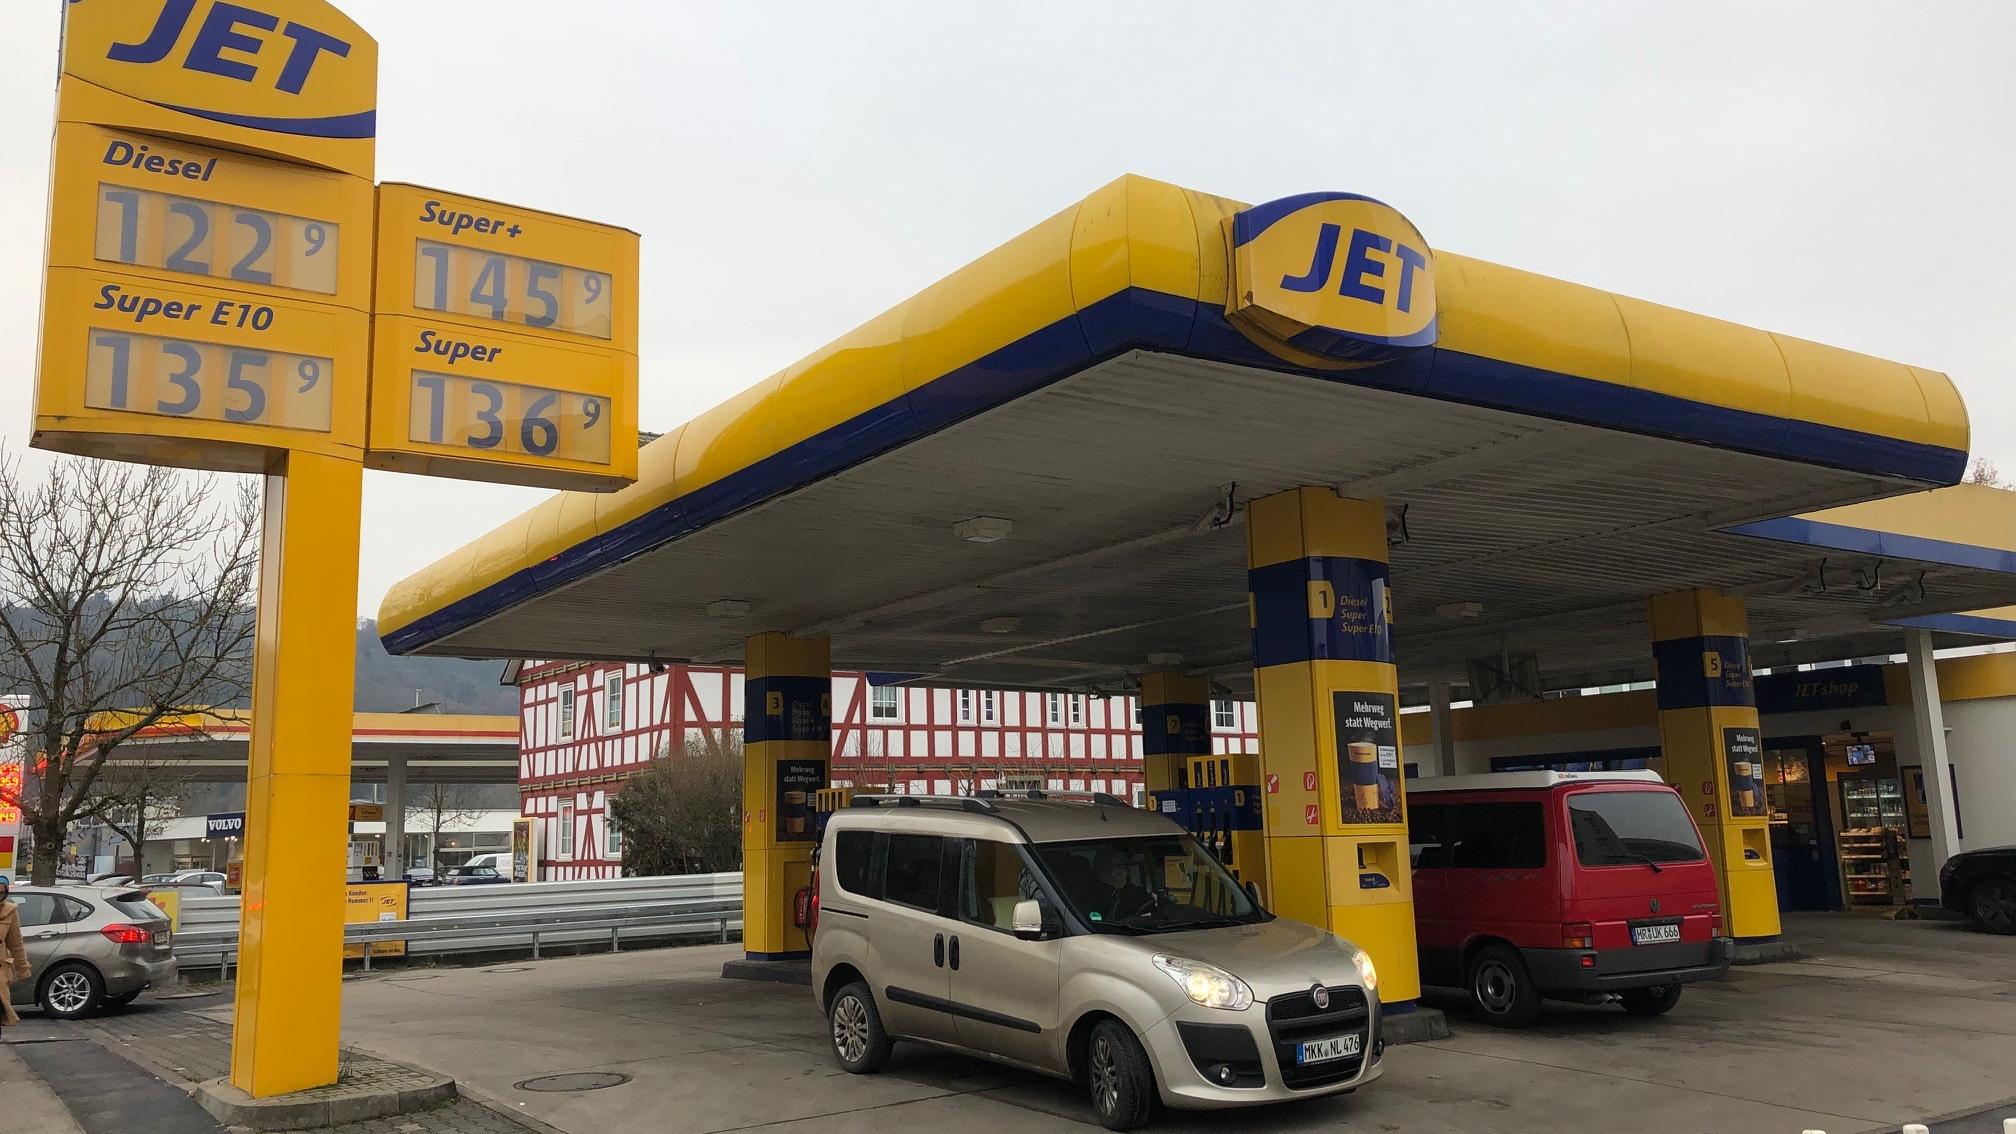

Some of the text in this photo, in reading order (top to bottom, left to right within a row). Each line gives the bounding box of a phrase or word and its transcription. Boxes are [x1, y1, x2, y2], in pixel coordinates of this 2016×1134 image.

[106, 0, 351, 96] JET
[103, 140, 218, 182] Diesel
[419, 201, 523, 241] Super+
[1279, 222, 1426, 314] JET
[93, 284, 274, 332] Super E10
[414, 330, 502, 366] Super
[1318, 590, 1328, 609] 1
[1339, 595, 1368, 607] Diesel
[1340, 608, 1367, 622] Super
[1340, 622, 1367, 635] Super
[1710, 658, 1718, 671] 5
[772, 697, 780, 709] 3
[1353, 701, 1385, 716] Mehrweg
[1171, 719, 1178, 729] 7
[1345, 716, 1363, 728] statt
[790, 766, 816, 775] Mehrweg
[784, 775, 797, 783] statt
[207, 817, 242, 831] VOLVO
[1664, 926, 1679, 938] 666
[1304, 1042, 1324, 1061] MKK
[1329, 1039, 1342, 1056] NL
[1343, 1035, 1359, 1053] 476
